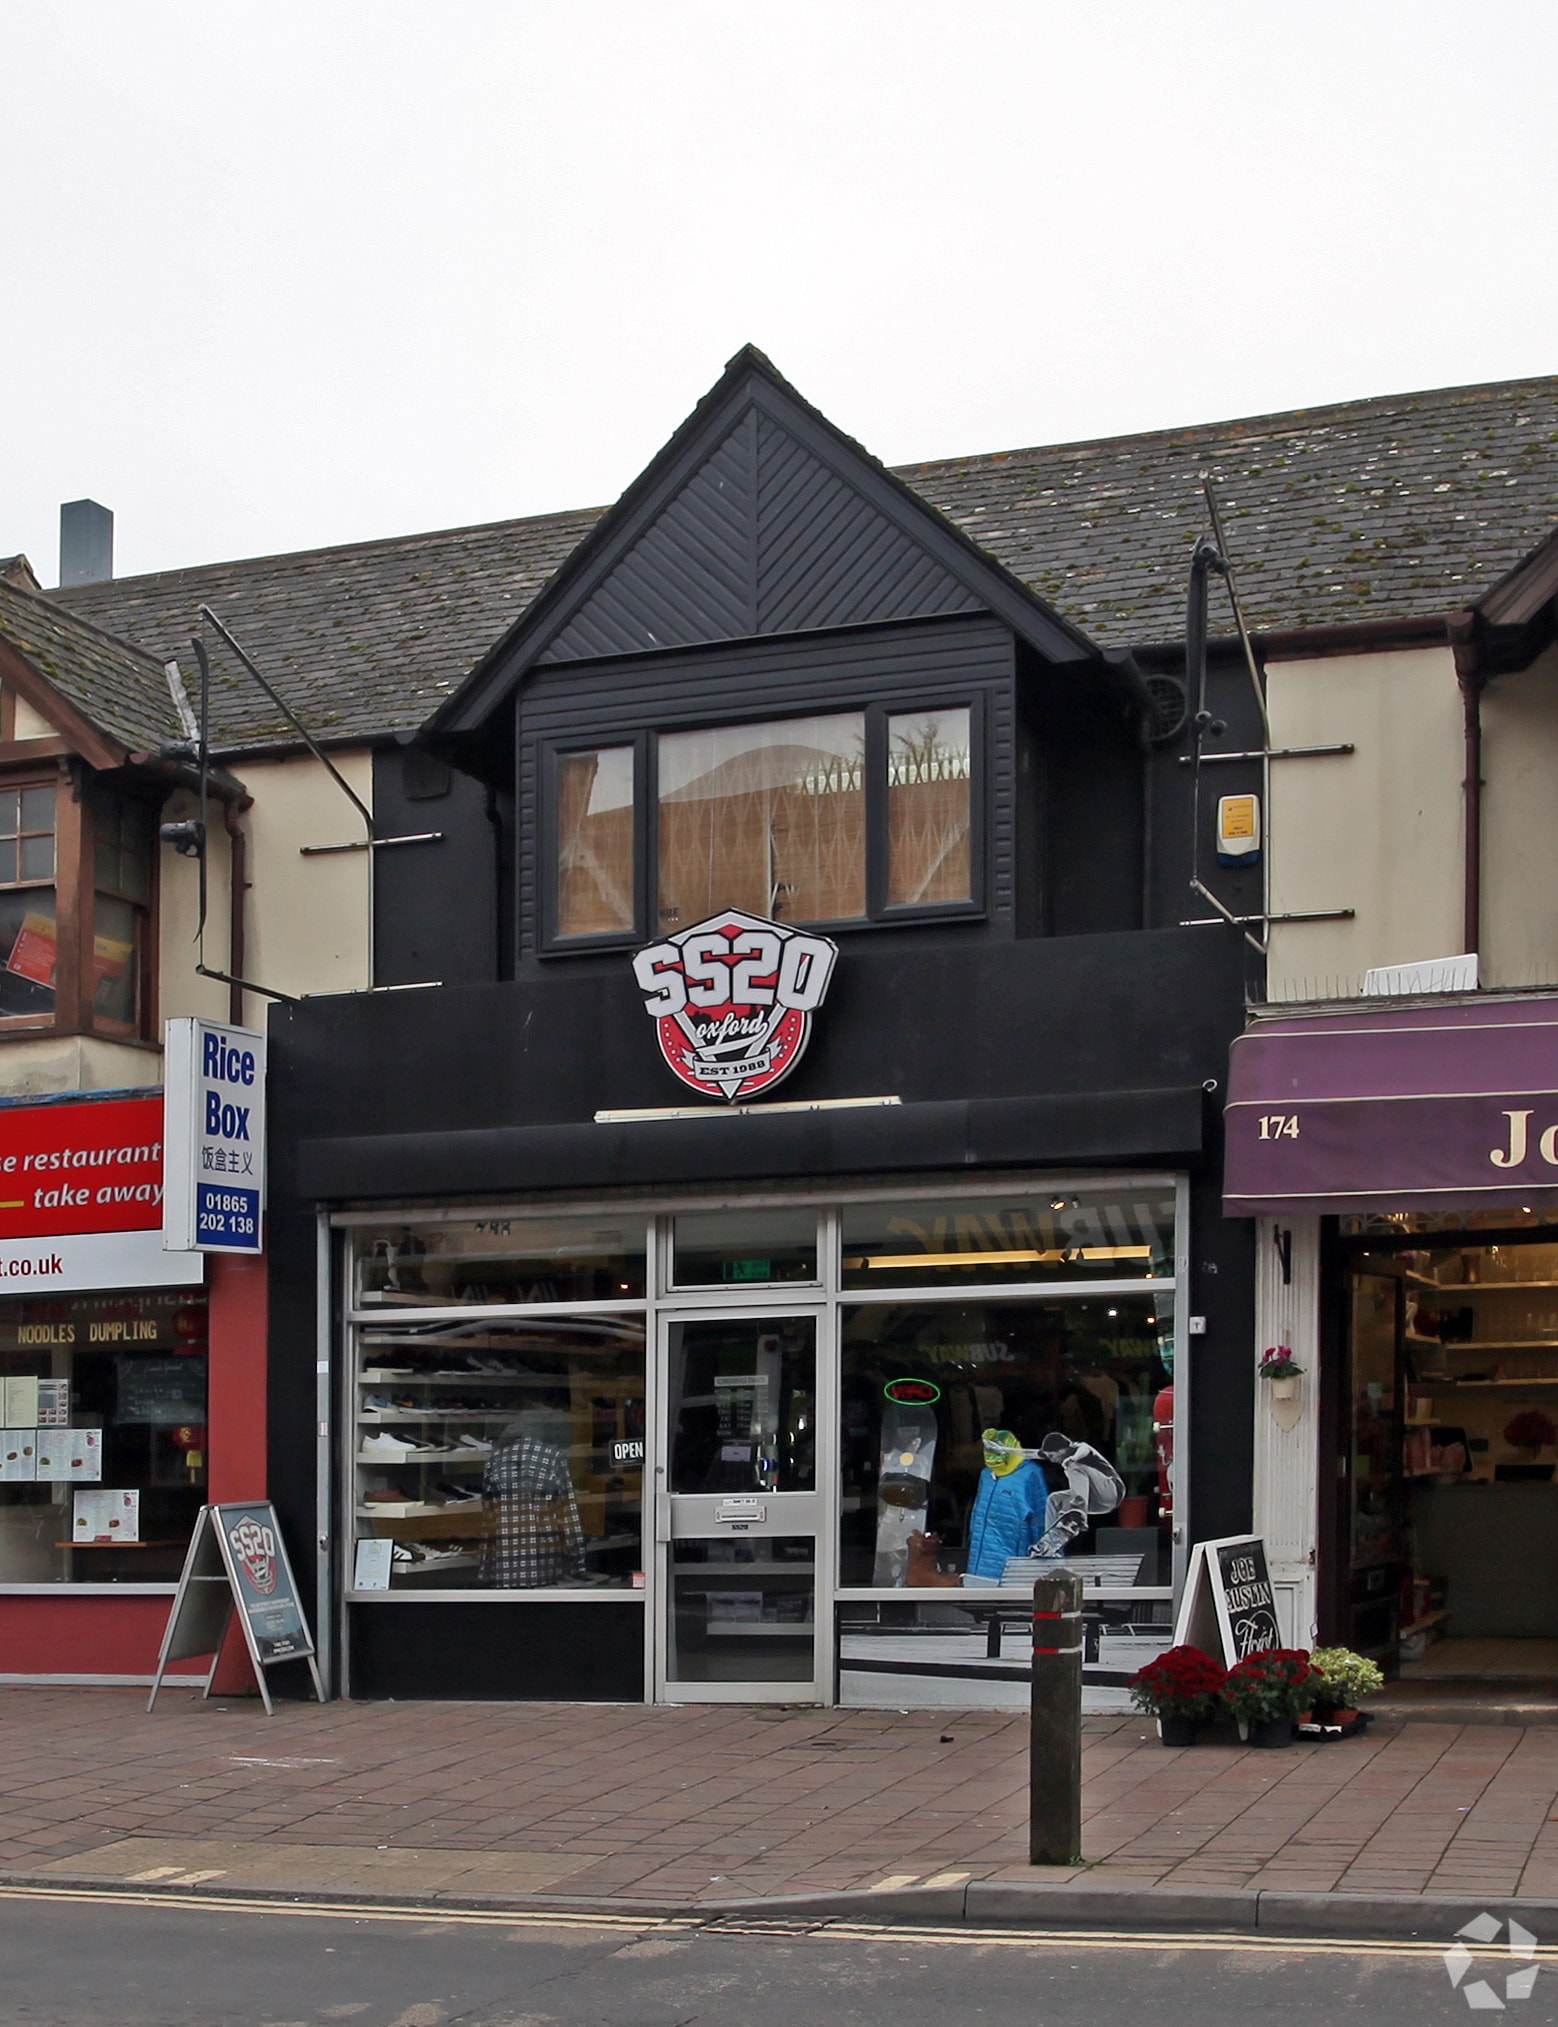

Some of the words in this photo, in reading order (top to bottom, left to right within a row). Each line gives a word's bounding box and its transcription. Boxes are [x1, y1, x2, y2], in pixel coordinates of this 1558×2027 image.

[631, 931, 835, 1019] SS20
[696, 1010, 768, 1048] oxford
[203, 1031, 255, 1086] Rice
[700, 1066, 730, 1076] EST
[732, 1059, 766, 1075] 1988
[205, 1089, 251, 1141] Box
[1257, 1115, 1300, 1140] 174
[0, 1155, 17, 1173] e
[22, 1141, 162, 1172] restaurant
[201, 1144, 254, 1176] 饭盒主义
[33, 1182, 90, 1209] take
[95, 1183, 164, 1207] away
[206, 1193, 248, 1213] 01865
[199, 1212, 225, 1231] 202
[229, 1216, 254, 1234] 138
[17, 1324, 76, 1344] NOODLES
[89, 1319, 158, 1343] DUMPLING
[614, 1441, 644, 1460] OPEN
[229, 1525, 276, 1562] SS20
[1231, 1556, 1256, 1583] JOE
[1225, 1582, 1271, 1613] AUSTIN
